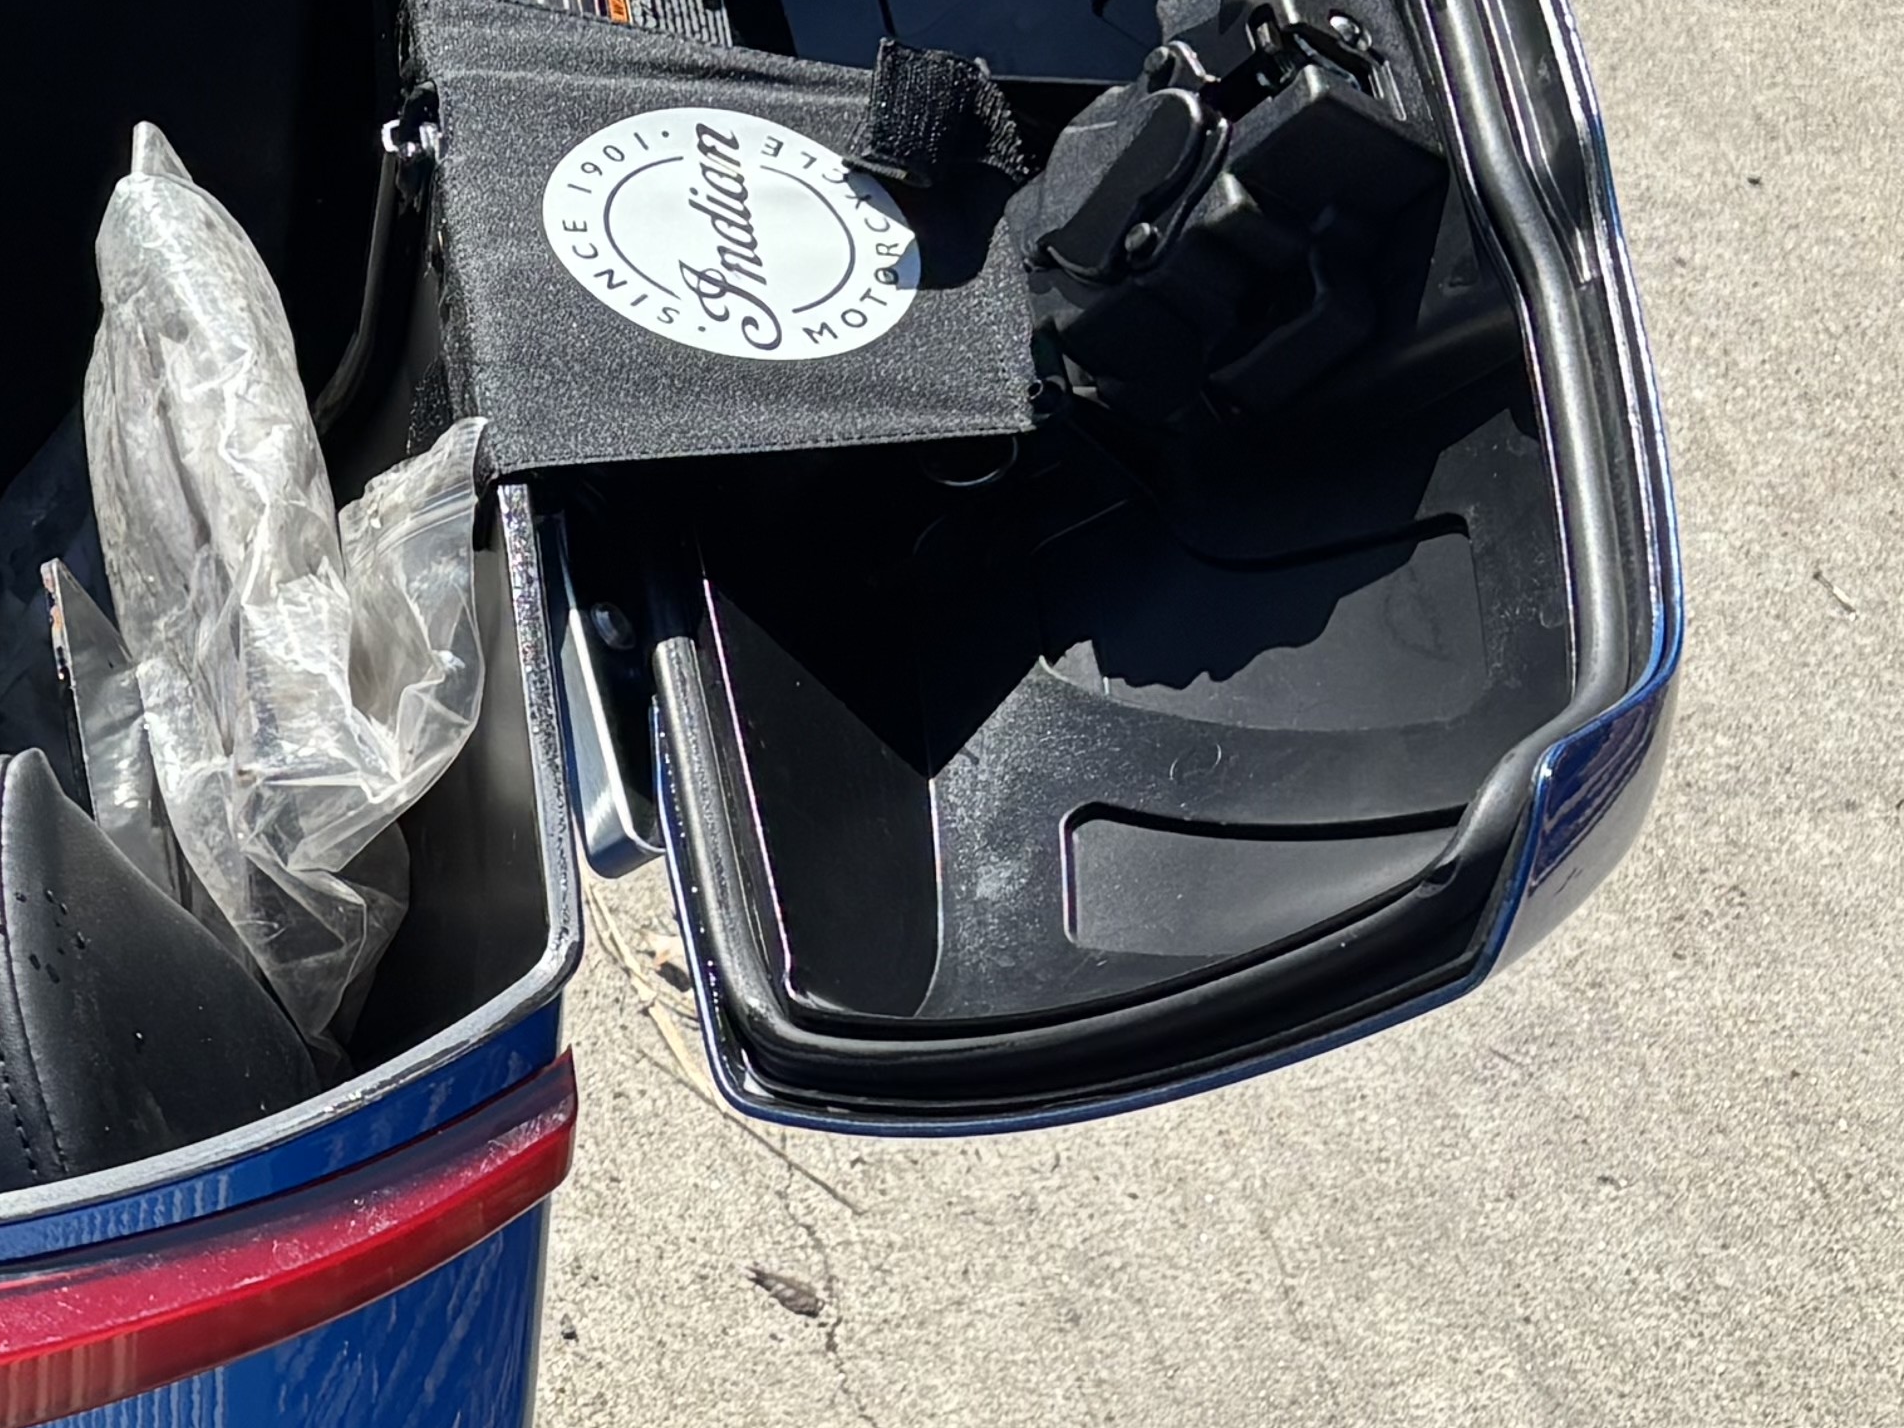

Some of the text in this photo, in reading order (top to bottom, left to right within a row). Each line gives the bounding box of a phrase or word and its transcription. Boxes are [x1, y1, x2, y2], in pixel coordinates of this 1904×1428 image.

[562, 132, 680, 326] SINCE 1901
[680, 122, 783, 351] Indian
